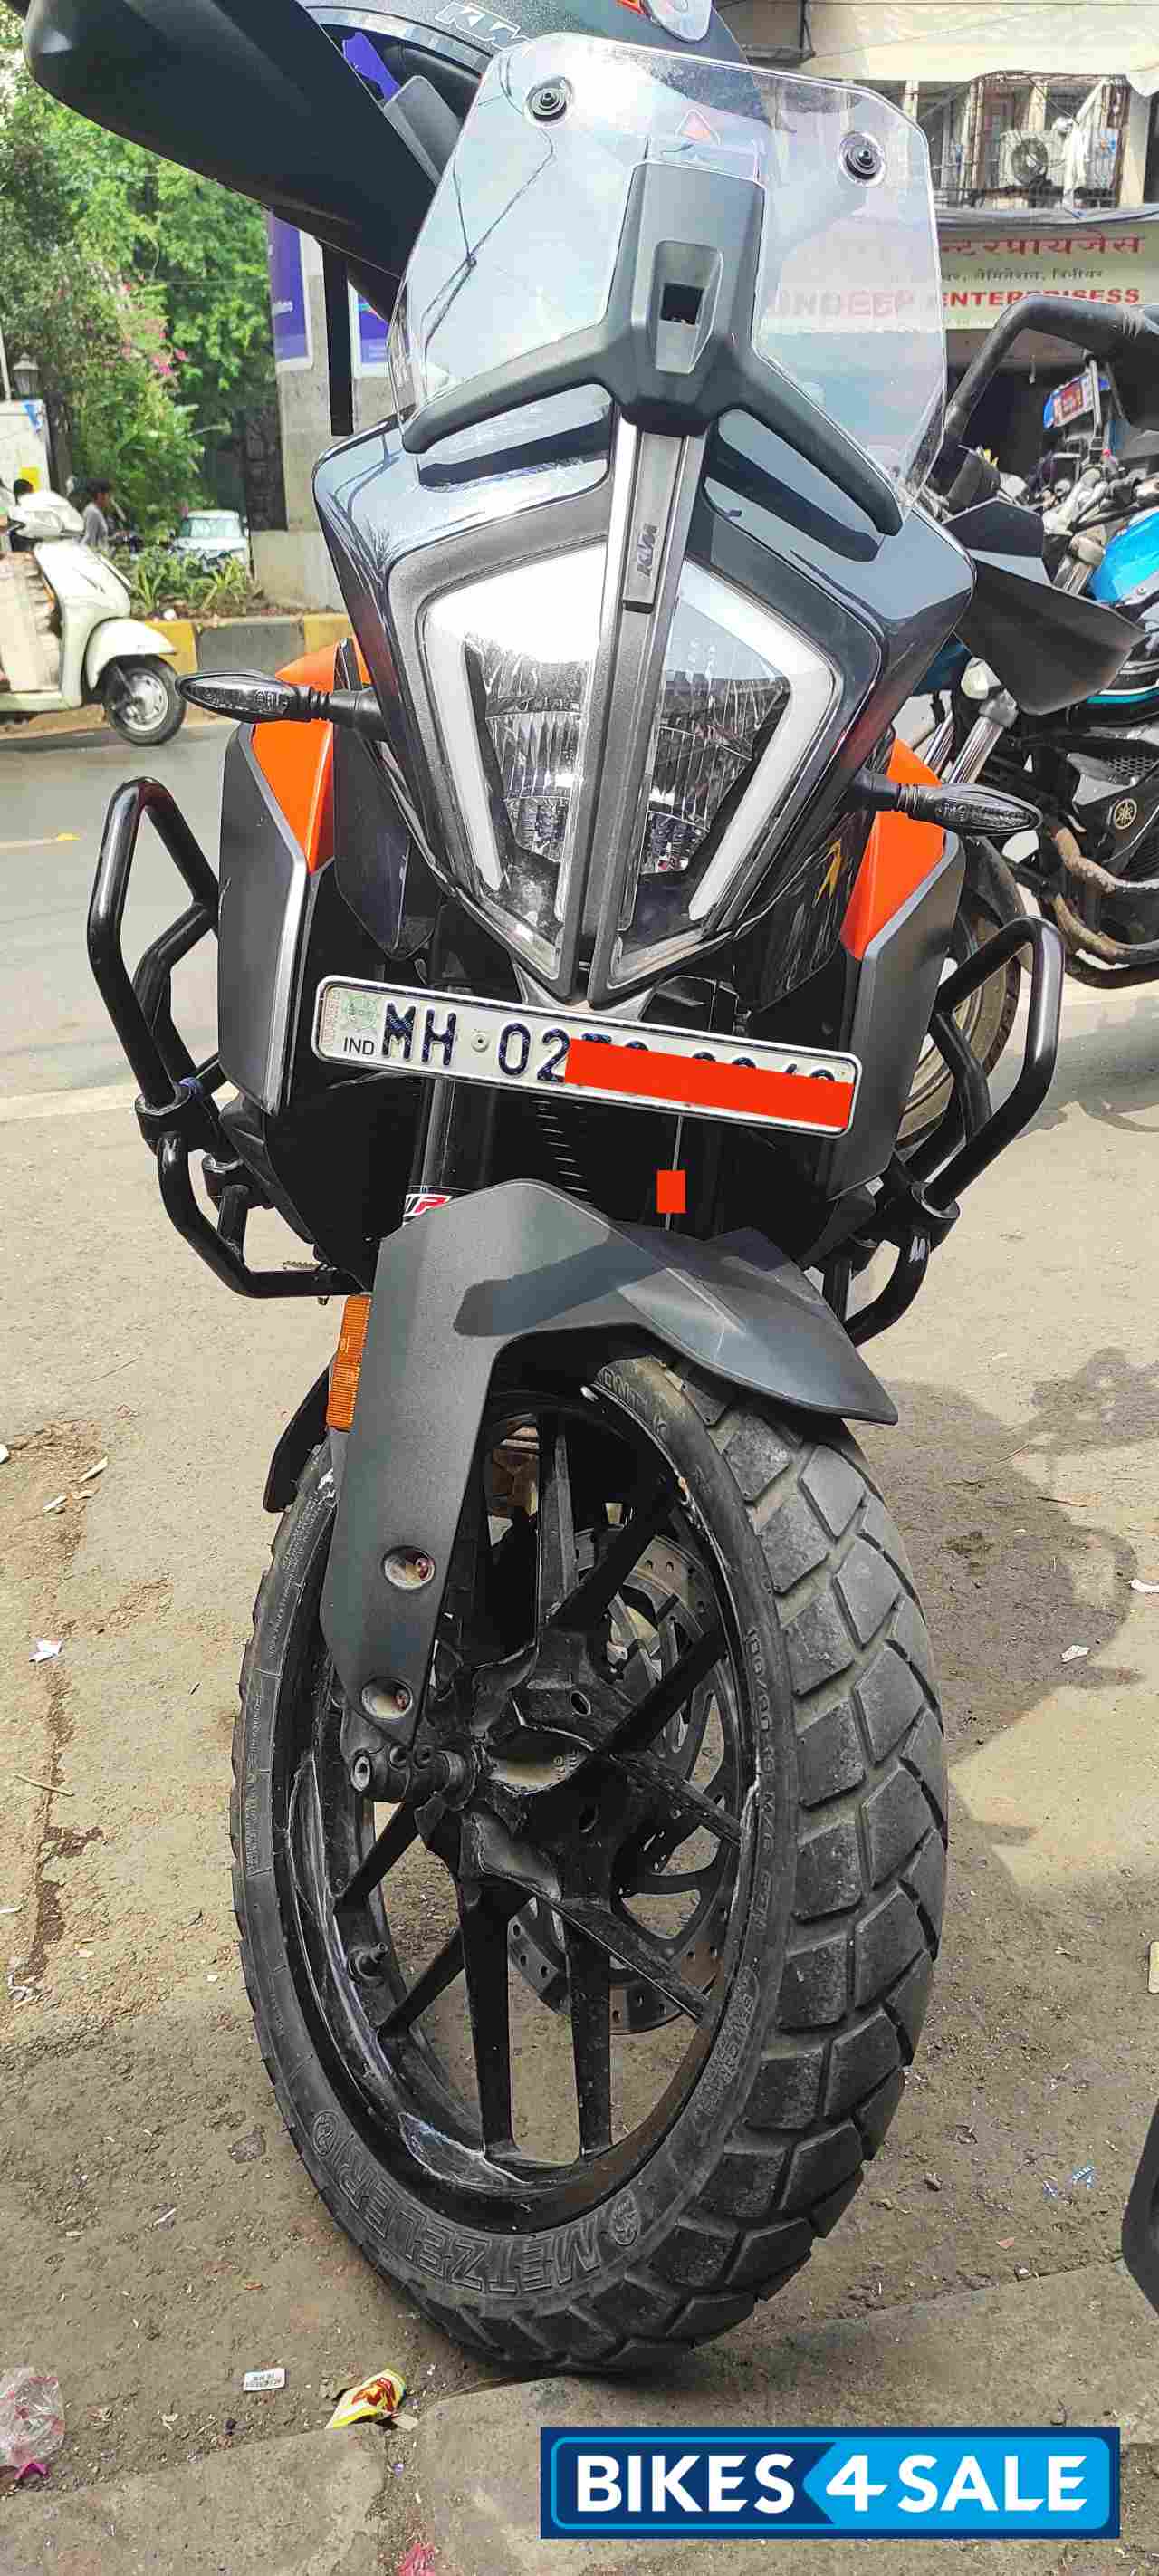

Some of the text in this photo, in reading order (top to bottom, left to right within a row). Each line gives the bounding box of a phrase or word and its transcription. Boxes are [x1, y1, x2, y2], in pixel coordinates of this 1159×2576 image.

[343, 1036, 375, 1055] IND
[382, 1002, 456, 1066] MH
[335, 2138, 603, 2293] METZELER
